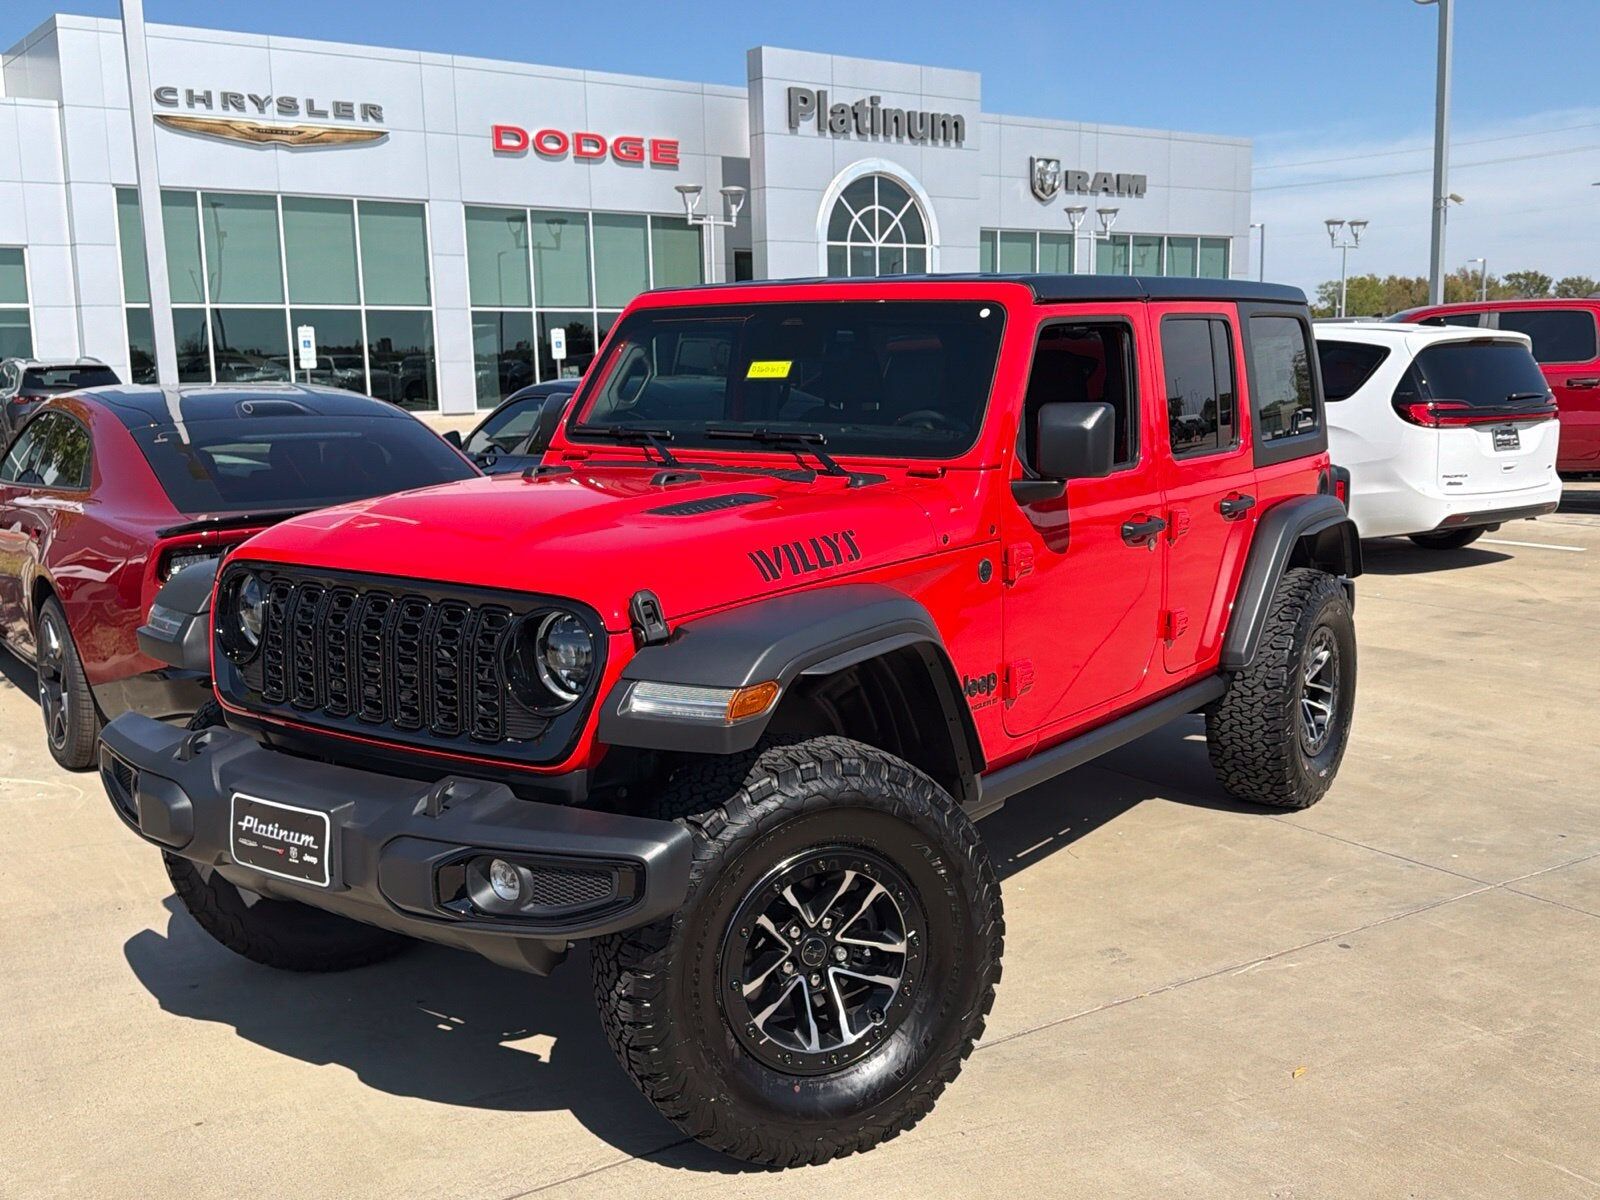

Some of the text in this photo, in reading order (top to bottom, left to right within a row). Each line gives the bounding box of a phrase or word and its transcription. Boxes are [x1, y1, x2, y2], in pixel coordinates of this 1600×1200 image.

[154, 86, 384, 122] CHRYSLER
[788, 87, 965, 142] Platinum
[492, 125, 679, 166] DODGE
[1065, 170, 1147, 195] RAM
[747, 529, 861, 582] WILLYS
[963, 672, 997, 697] Jeep
[238, 815, 318, 849] Platinum
